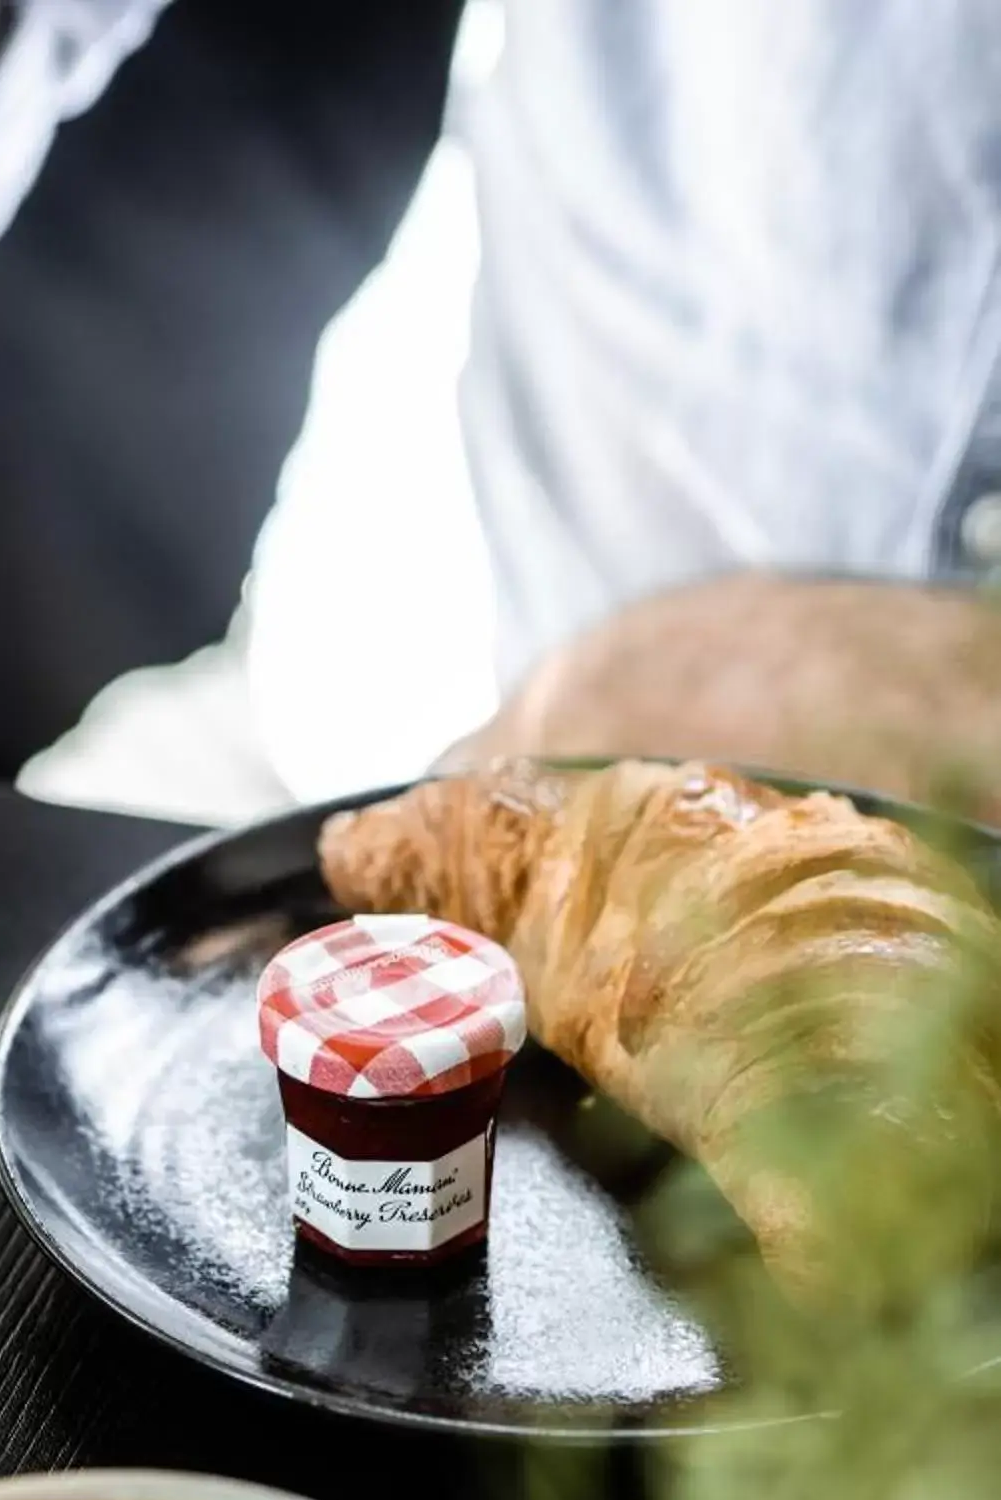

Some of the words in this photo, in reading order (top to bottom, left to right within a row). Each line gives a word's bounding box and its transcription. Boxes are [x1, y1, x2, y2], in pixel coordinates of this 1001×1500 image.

[312, 1151, 370, 1194] Bonne
[297, 1171, 372, 1230] Strawberry
[379, 1188, 473, 1222] Preserves
